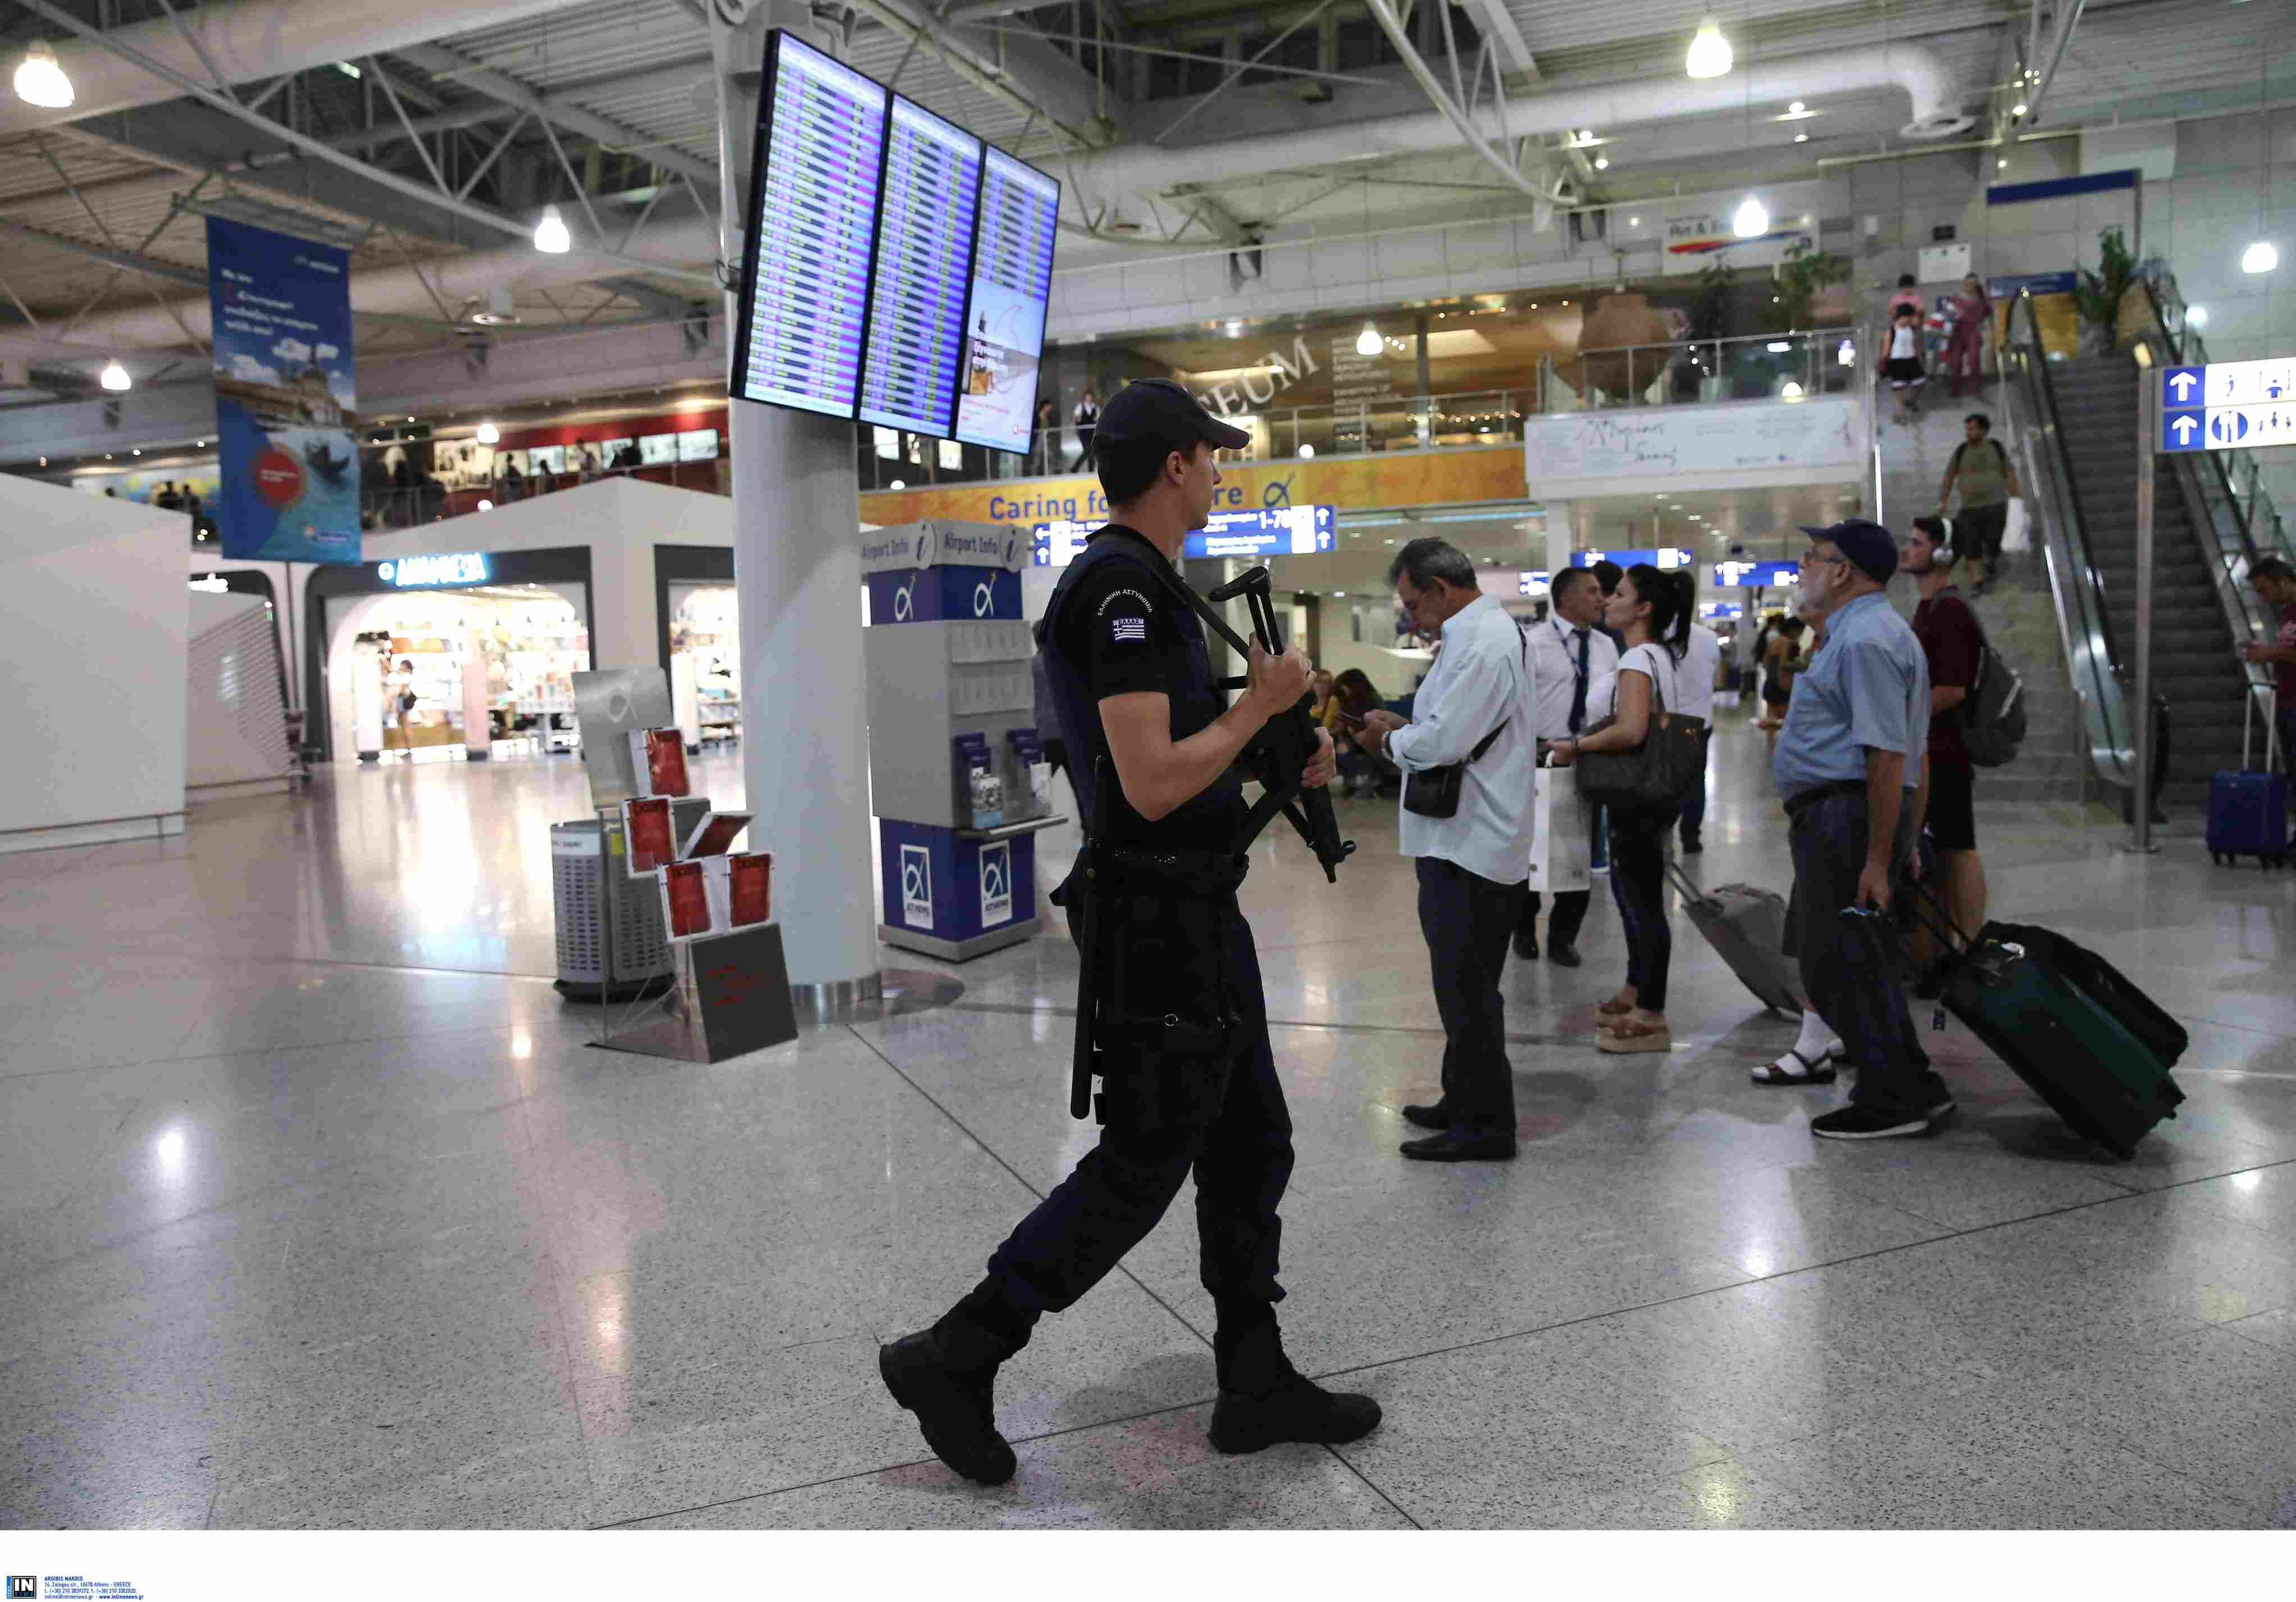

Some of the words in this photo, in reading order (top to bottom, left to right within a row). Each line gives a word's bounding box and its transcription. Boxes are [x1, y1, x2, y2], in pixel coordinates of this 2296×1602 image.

[990, 491, 1076, 521] Caring
[1087, 486, 1110, 514] fo
[1213, 486, 1243, 505] re
[944, 531, 977, 555] Airport
[980, 537, 999, 555] Info
[1097, 590, 1121, 615] ΕΛΛΗΝΙΚΗ
[1123, 589, 1152, 613] ΑΣΤΥΝΟΜΙΑ
